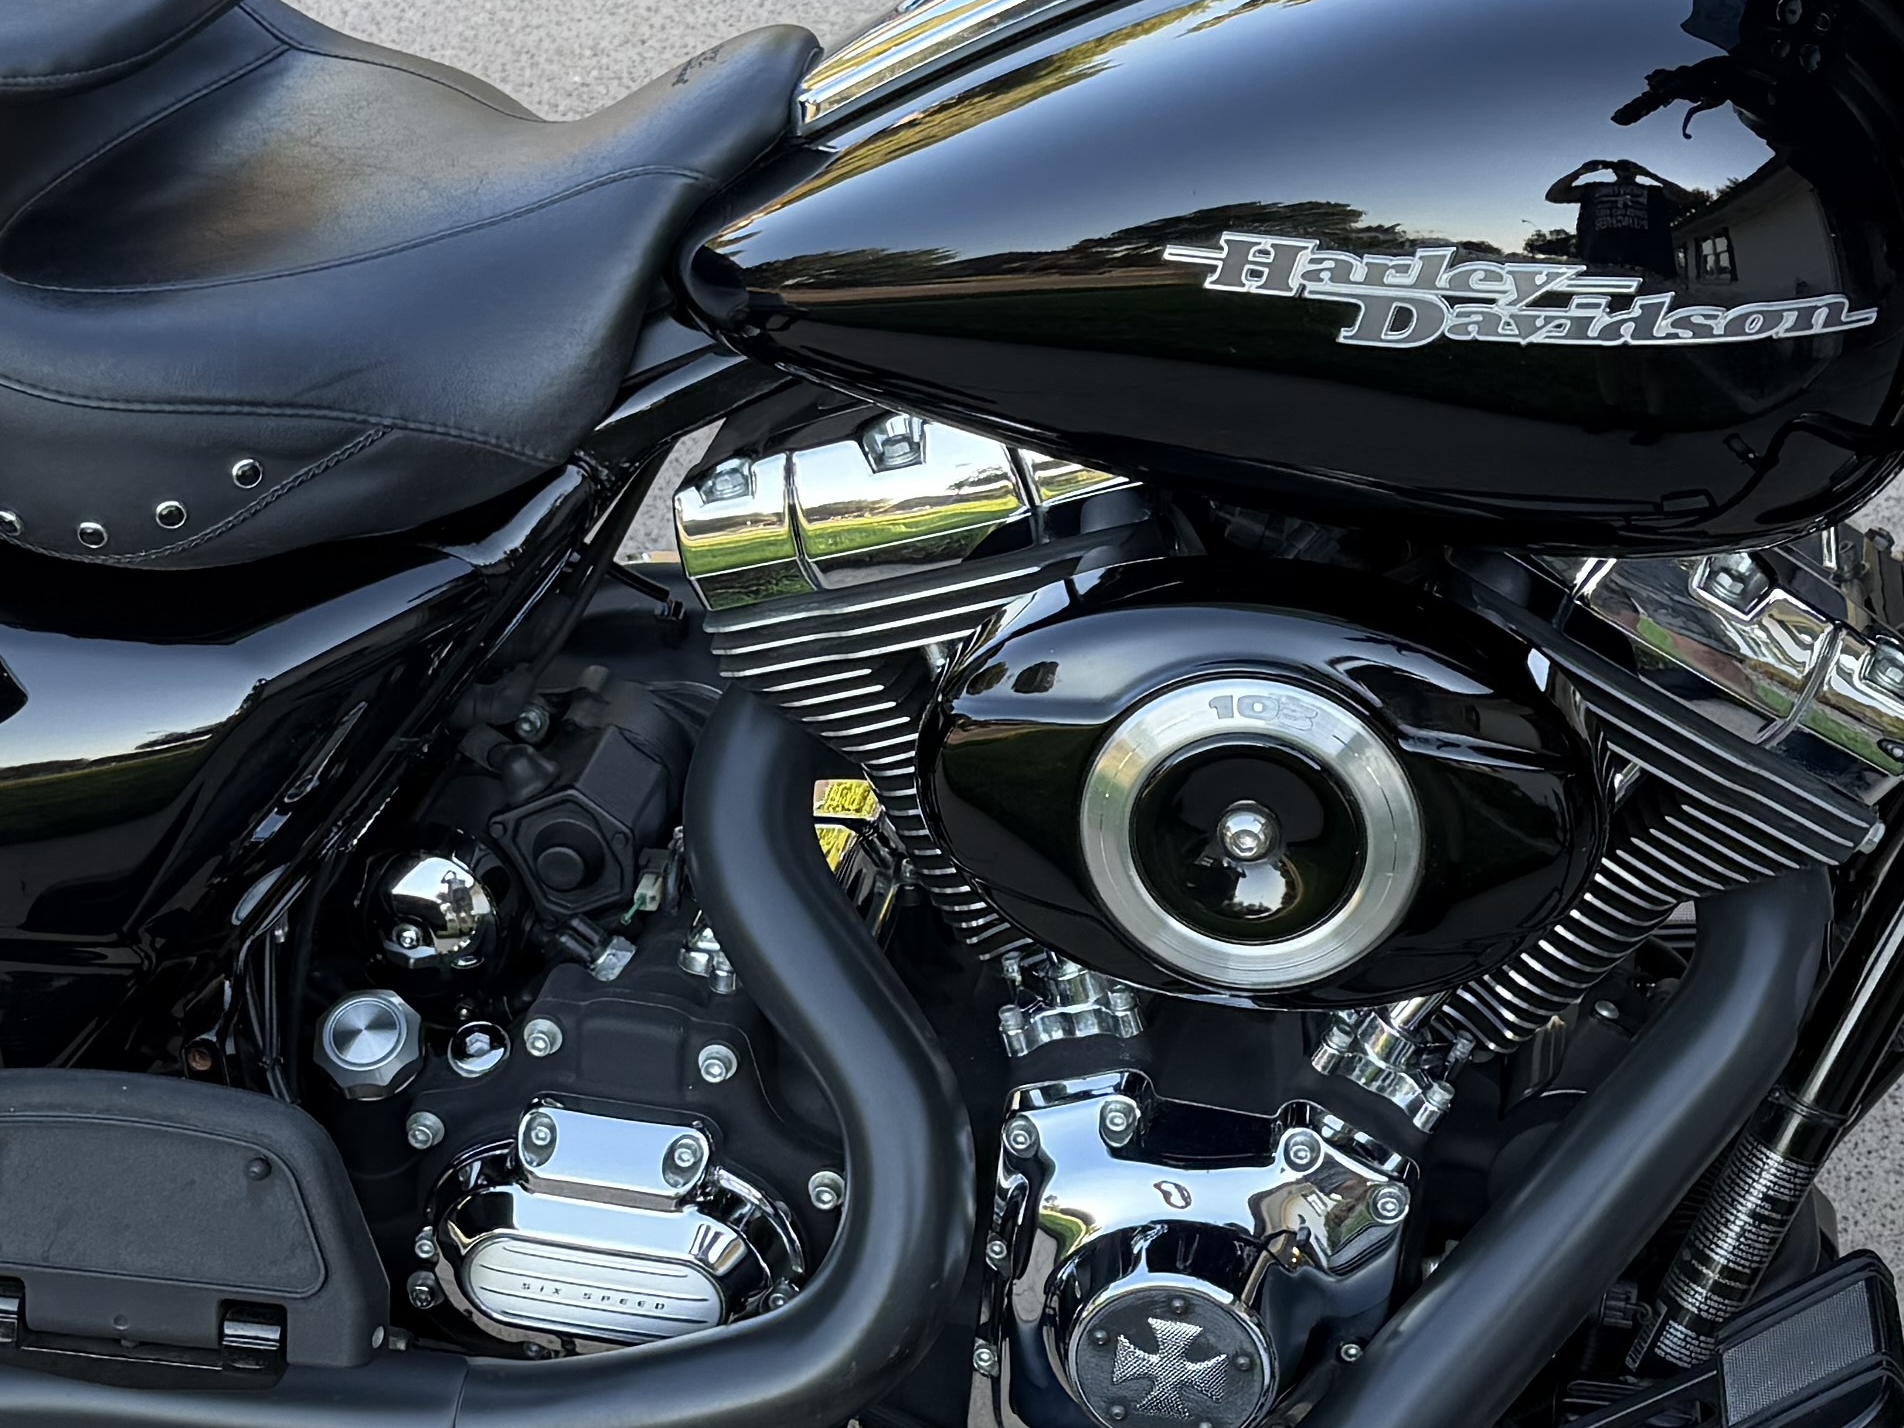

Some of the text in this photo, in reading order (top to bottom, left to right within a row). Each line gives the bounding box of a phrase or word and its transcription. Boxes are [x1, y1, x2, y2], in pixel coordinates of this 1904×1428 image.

[1194, 232, 1596, 310] Harley
[1336, 290, 1878, 346] Davidson
[520, 1281, 666, 1311] SIX SPEED
